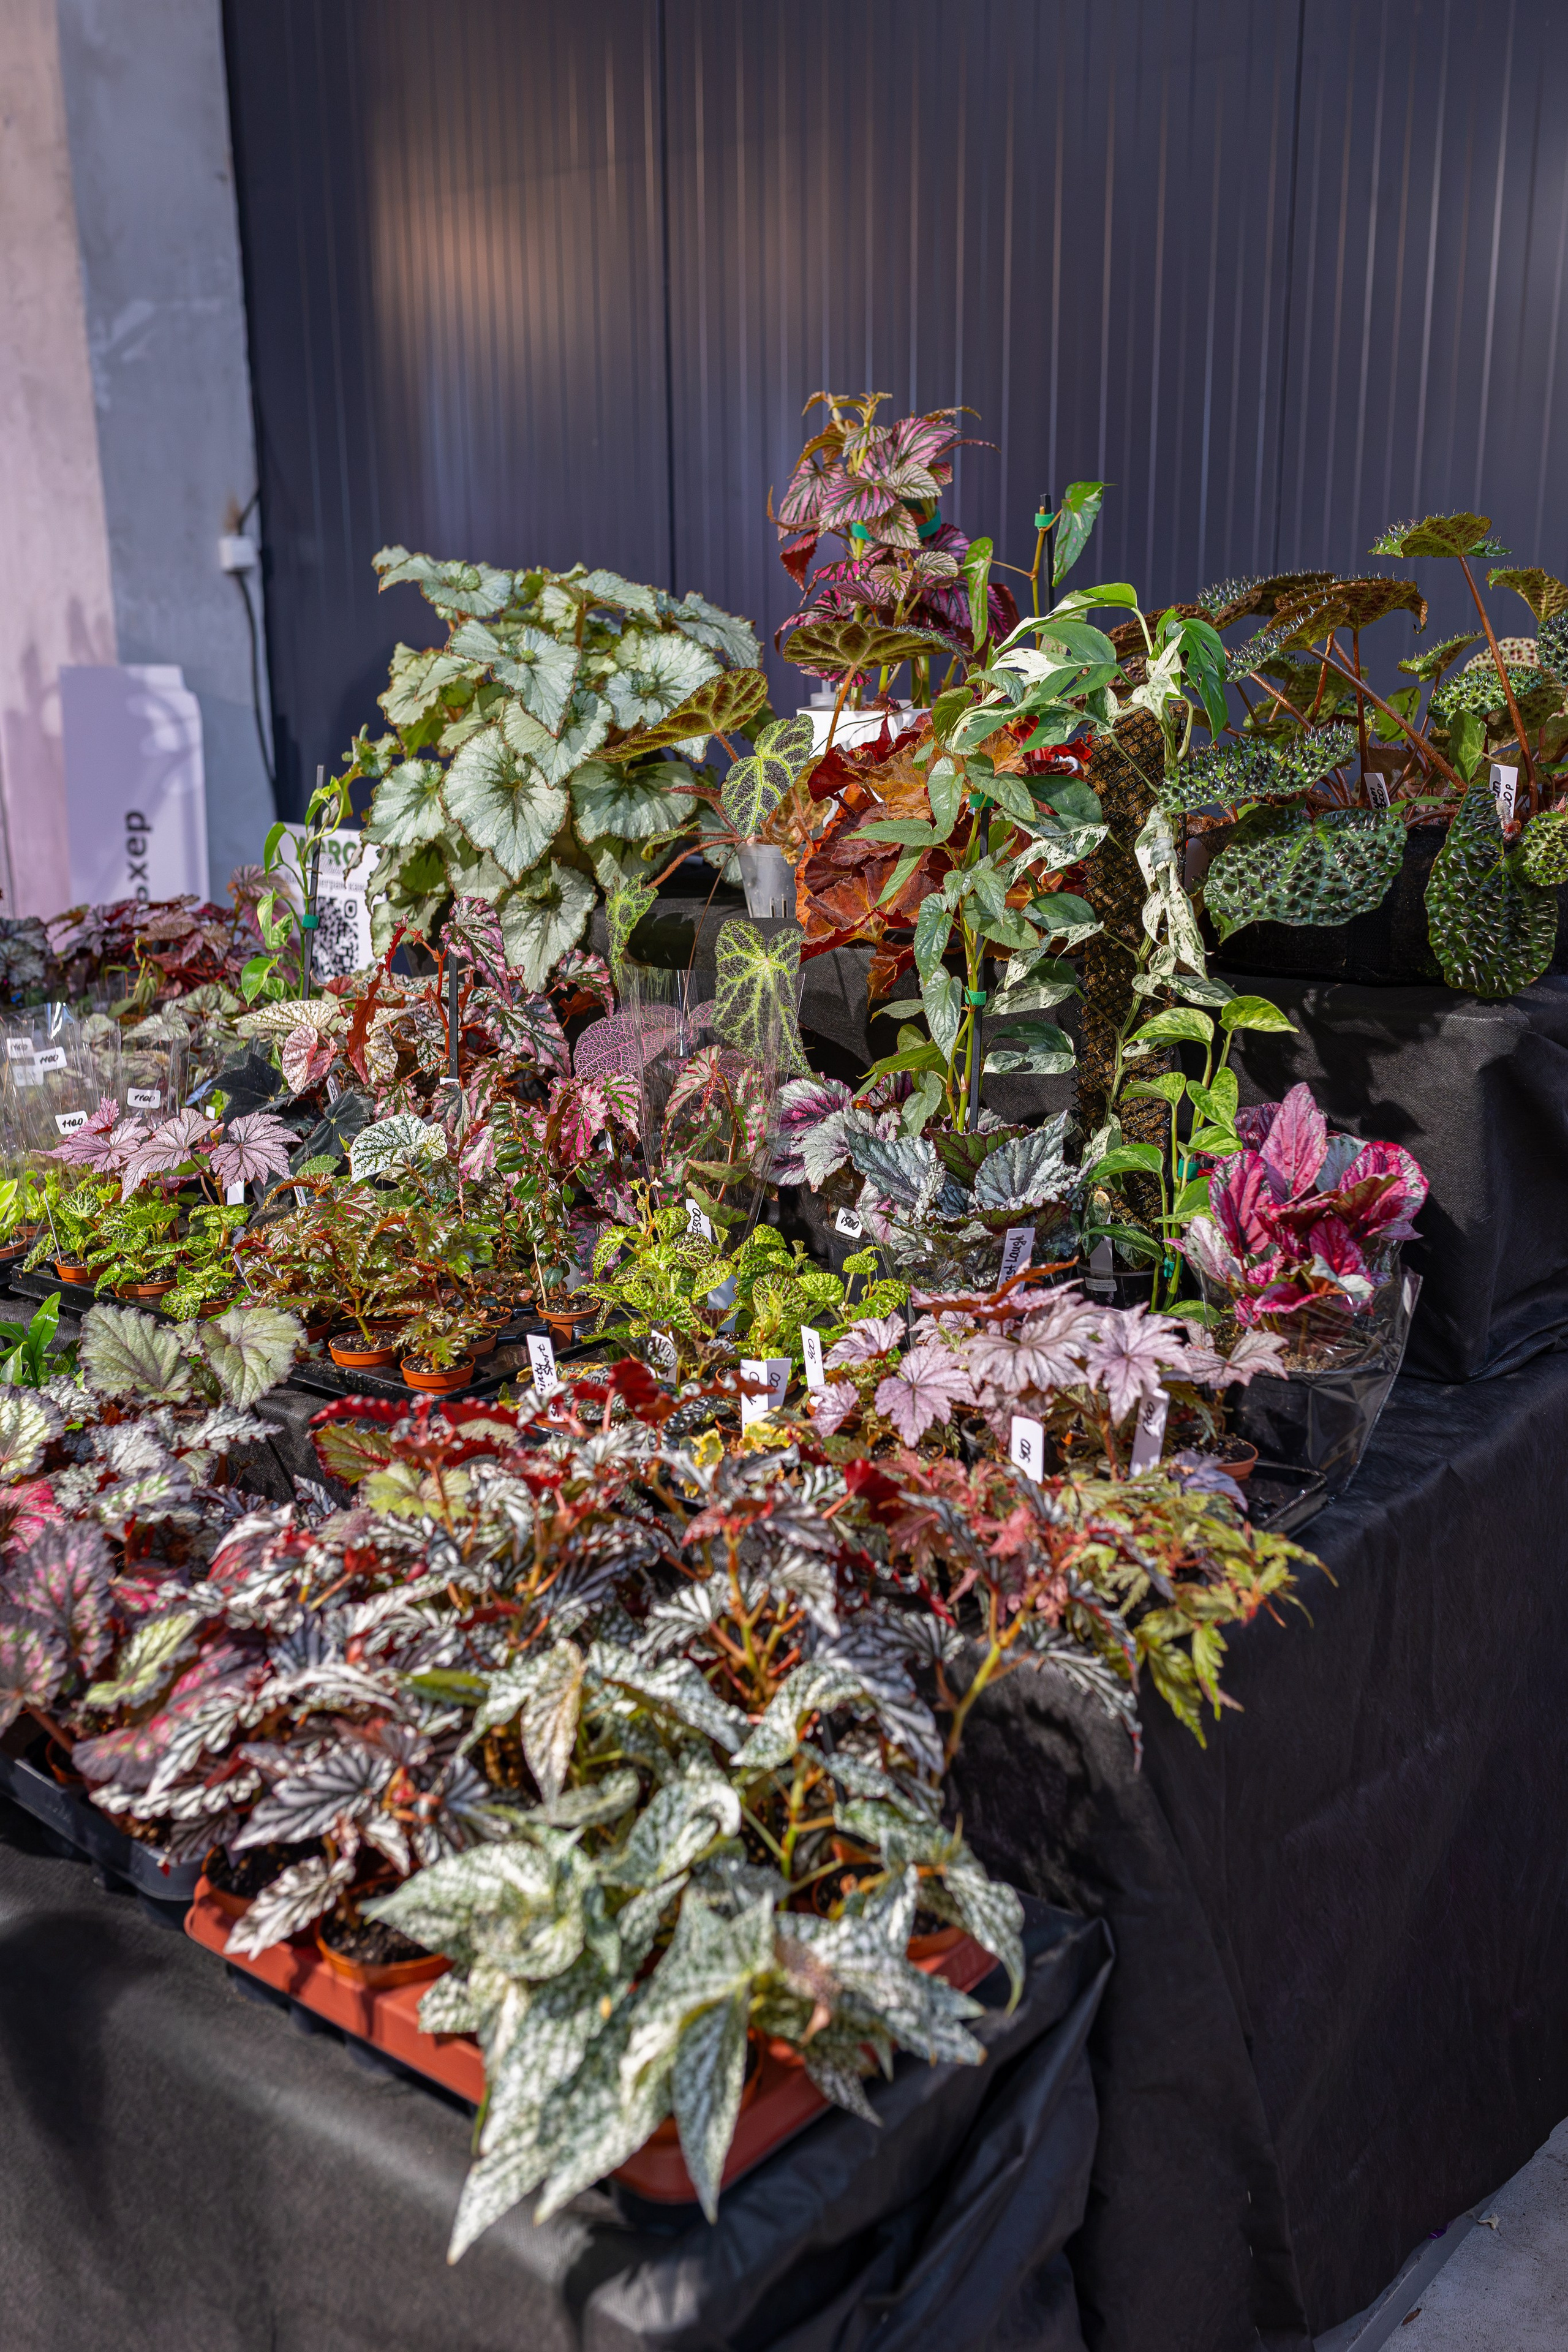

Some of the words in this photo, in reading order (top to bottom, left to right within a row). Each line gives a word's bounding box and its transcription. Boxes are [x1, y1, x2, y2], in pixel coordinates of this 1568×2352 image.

[134, 1094, 155, 1102] 1100
[62, 1117, 83, 1128] 1100
[1005, 1234, 1027, 1262] Laugh
